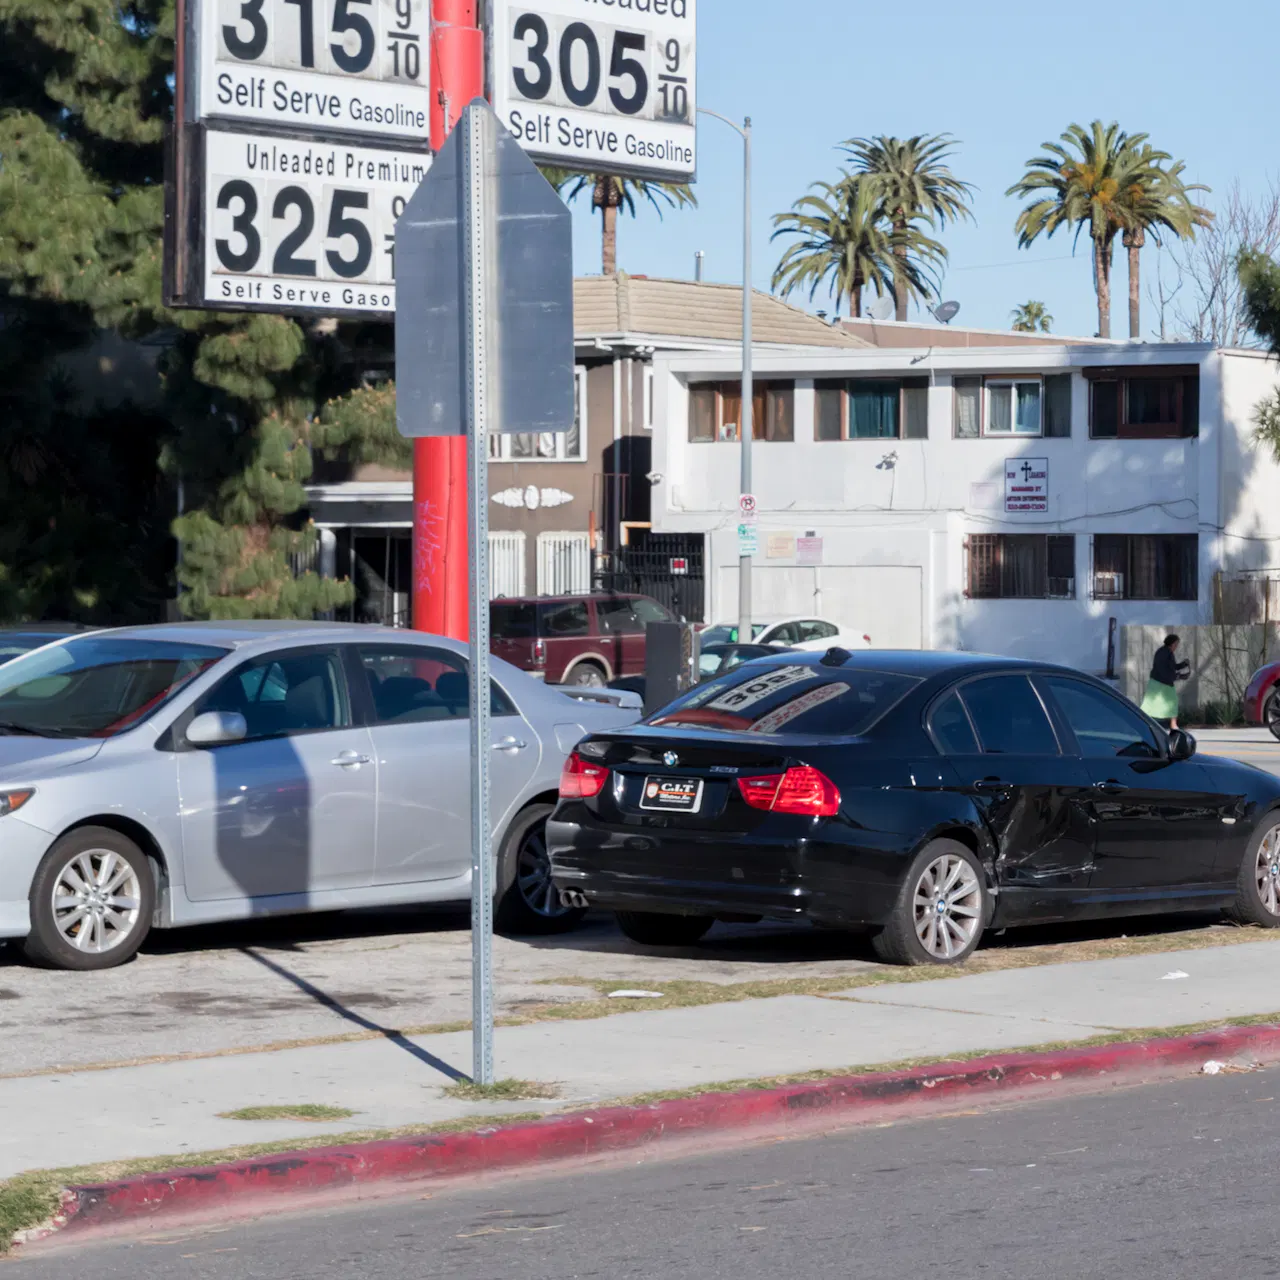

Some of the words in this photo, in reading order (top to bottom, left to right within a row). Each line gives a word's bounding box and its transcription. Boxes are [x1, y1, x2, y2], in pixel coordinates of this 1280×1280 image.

[388, 41, 421, 81] 10
[513, 13, 648, 115] 305
[664, 38, 681, 73] 9
[217, 72, 265, 109] Self
[273, 81, 341, 117] Serve
[349, 97, 426, 129] Gasoline
[659, 83, 688, 119] 10
[509, 110, 551, 145] Self
[558, 117, 619, 153] Serve
[625, 134, 693, 165] Gasoline
[246, 143, 335, 177] Unleaded
[345, 153, 425, 183] Premium
[214, 179, 372, 278] 325
[221, 280, 263, 299] Self
[272, 286, 332, 304] Serve
